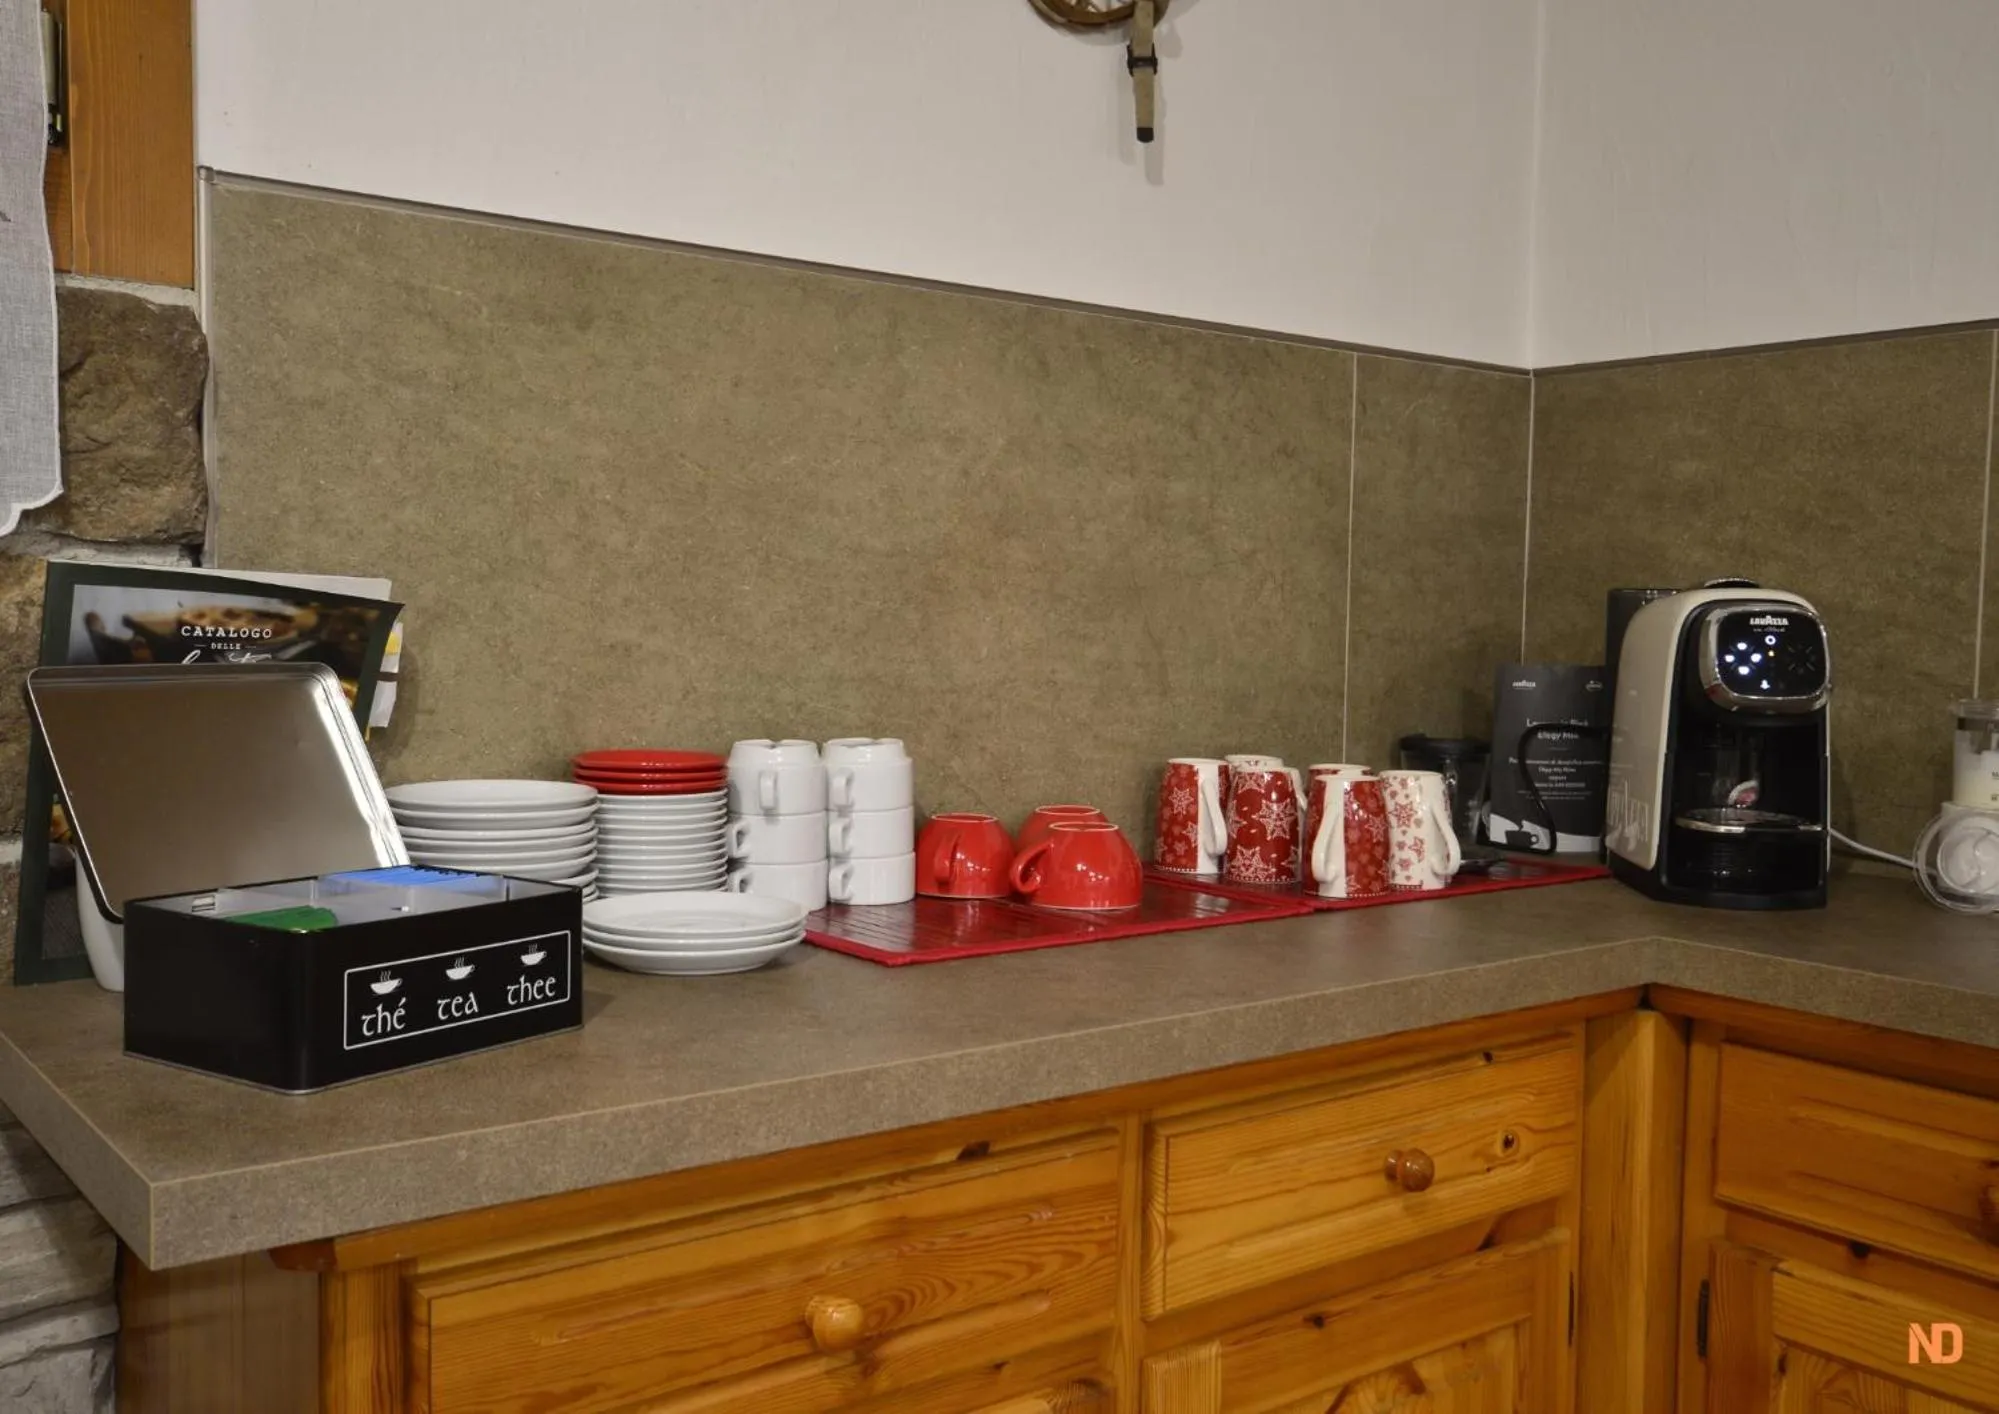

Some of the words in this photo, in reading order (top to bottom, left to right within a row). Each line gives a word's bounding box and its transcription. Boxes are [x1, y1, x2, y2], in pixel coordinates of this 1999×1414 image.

[1749, 615, 1789, 626] LAVAZZA
[181, 626, 272, 639] CATALOGO
[361, 997, 407, 1036] thé
[437, 992, 479, 1020] tea
[507, 975, 556, 1005] thee
